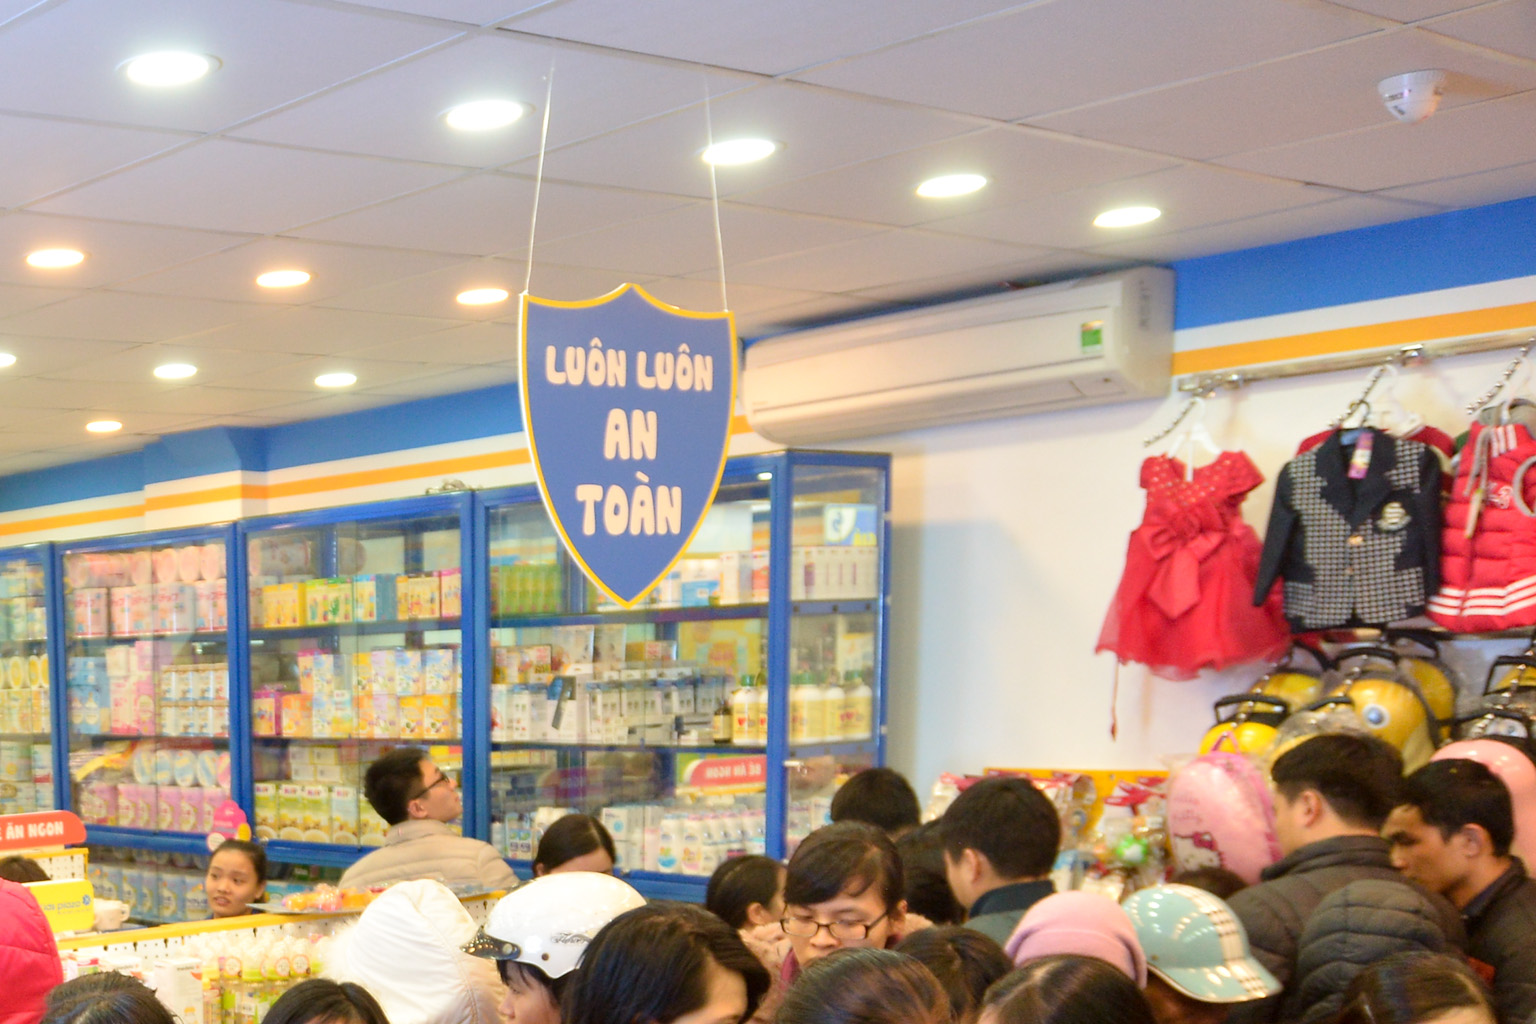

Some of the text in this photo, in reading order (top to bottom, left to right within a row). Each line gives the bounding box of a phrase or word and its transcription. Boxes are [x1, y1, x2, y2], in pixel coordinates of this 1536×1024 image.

[545, 337, 713, 391] LUÔN LUÔN
[604, 408, 657, 460] AN
[575, 471, 682, 536] TOÀN
[6, 822, 24, 840] ĂN
[28, 821, 64, 838] NGON
